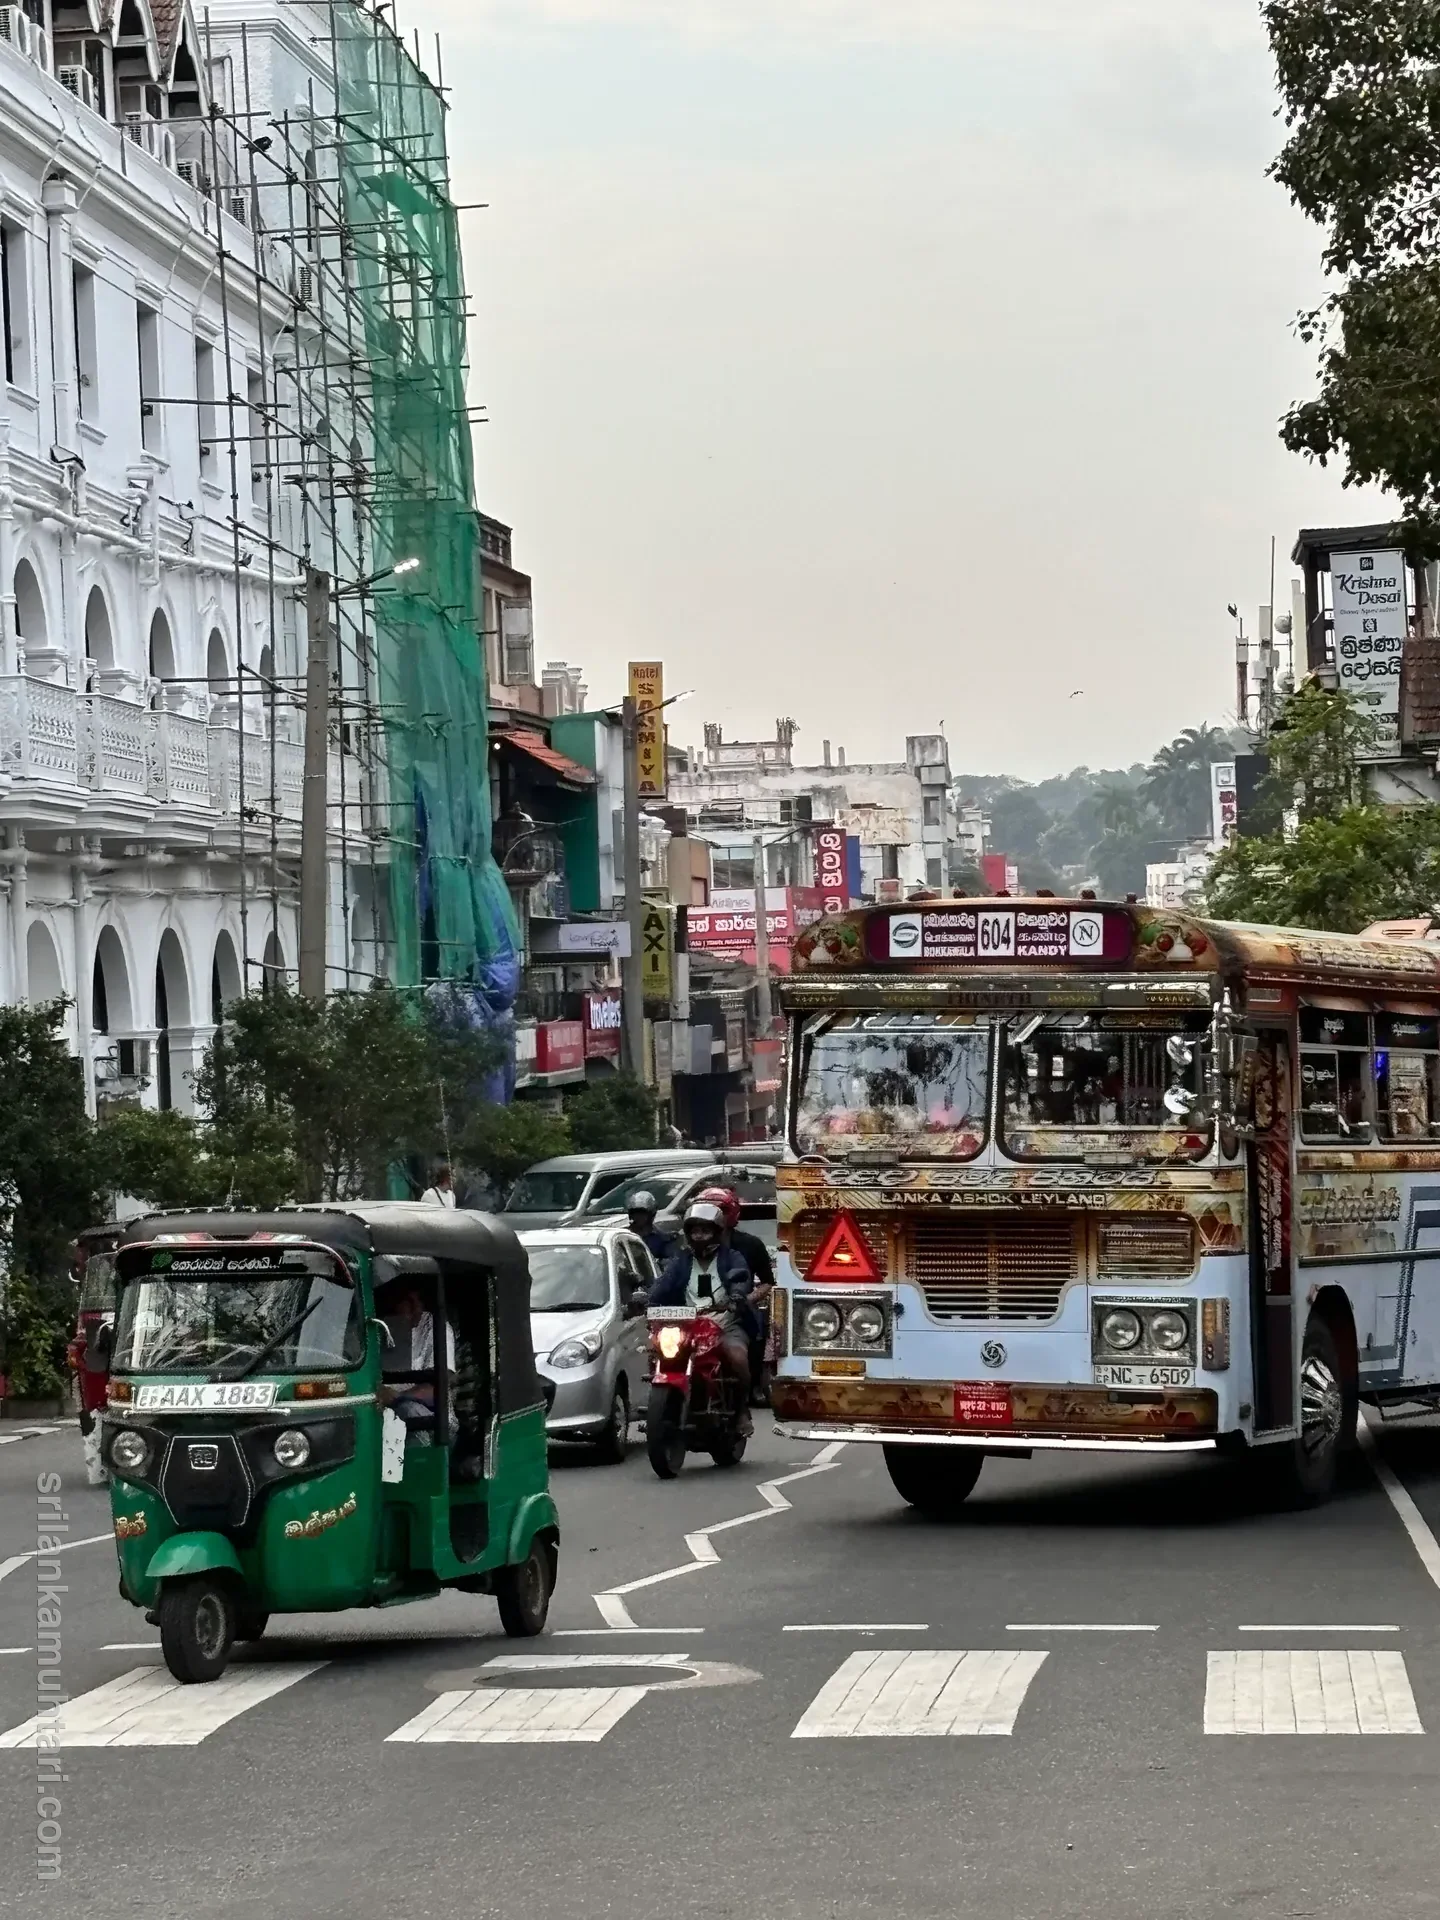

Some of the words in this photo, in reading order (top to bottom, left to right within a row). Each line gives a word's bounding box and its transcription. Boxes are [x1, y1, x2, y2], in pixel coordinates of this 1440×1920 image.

[1335, 574, 1397, 594] Krishna
[1358, 590, 1401, 605] Dosai
[981, 917, 1012, 951] 604
[1079, 925, 1093, 941] N
[1017, 945, 1068, 956] KANDY
[881, 1192, 941, 1205] LANKA
[950, 1192, 1013, 1206] ASHOK
[1020, 1192, 1106, 1207] LEYLAND
